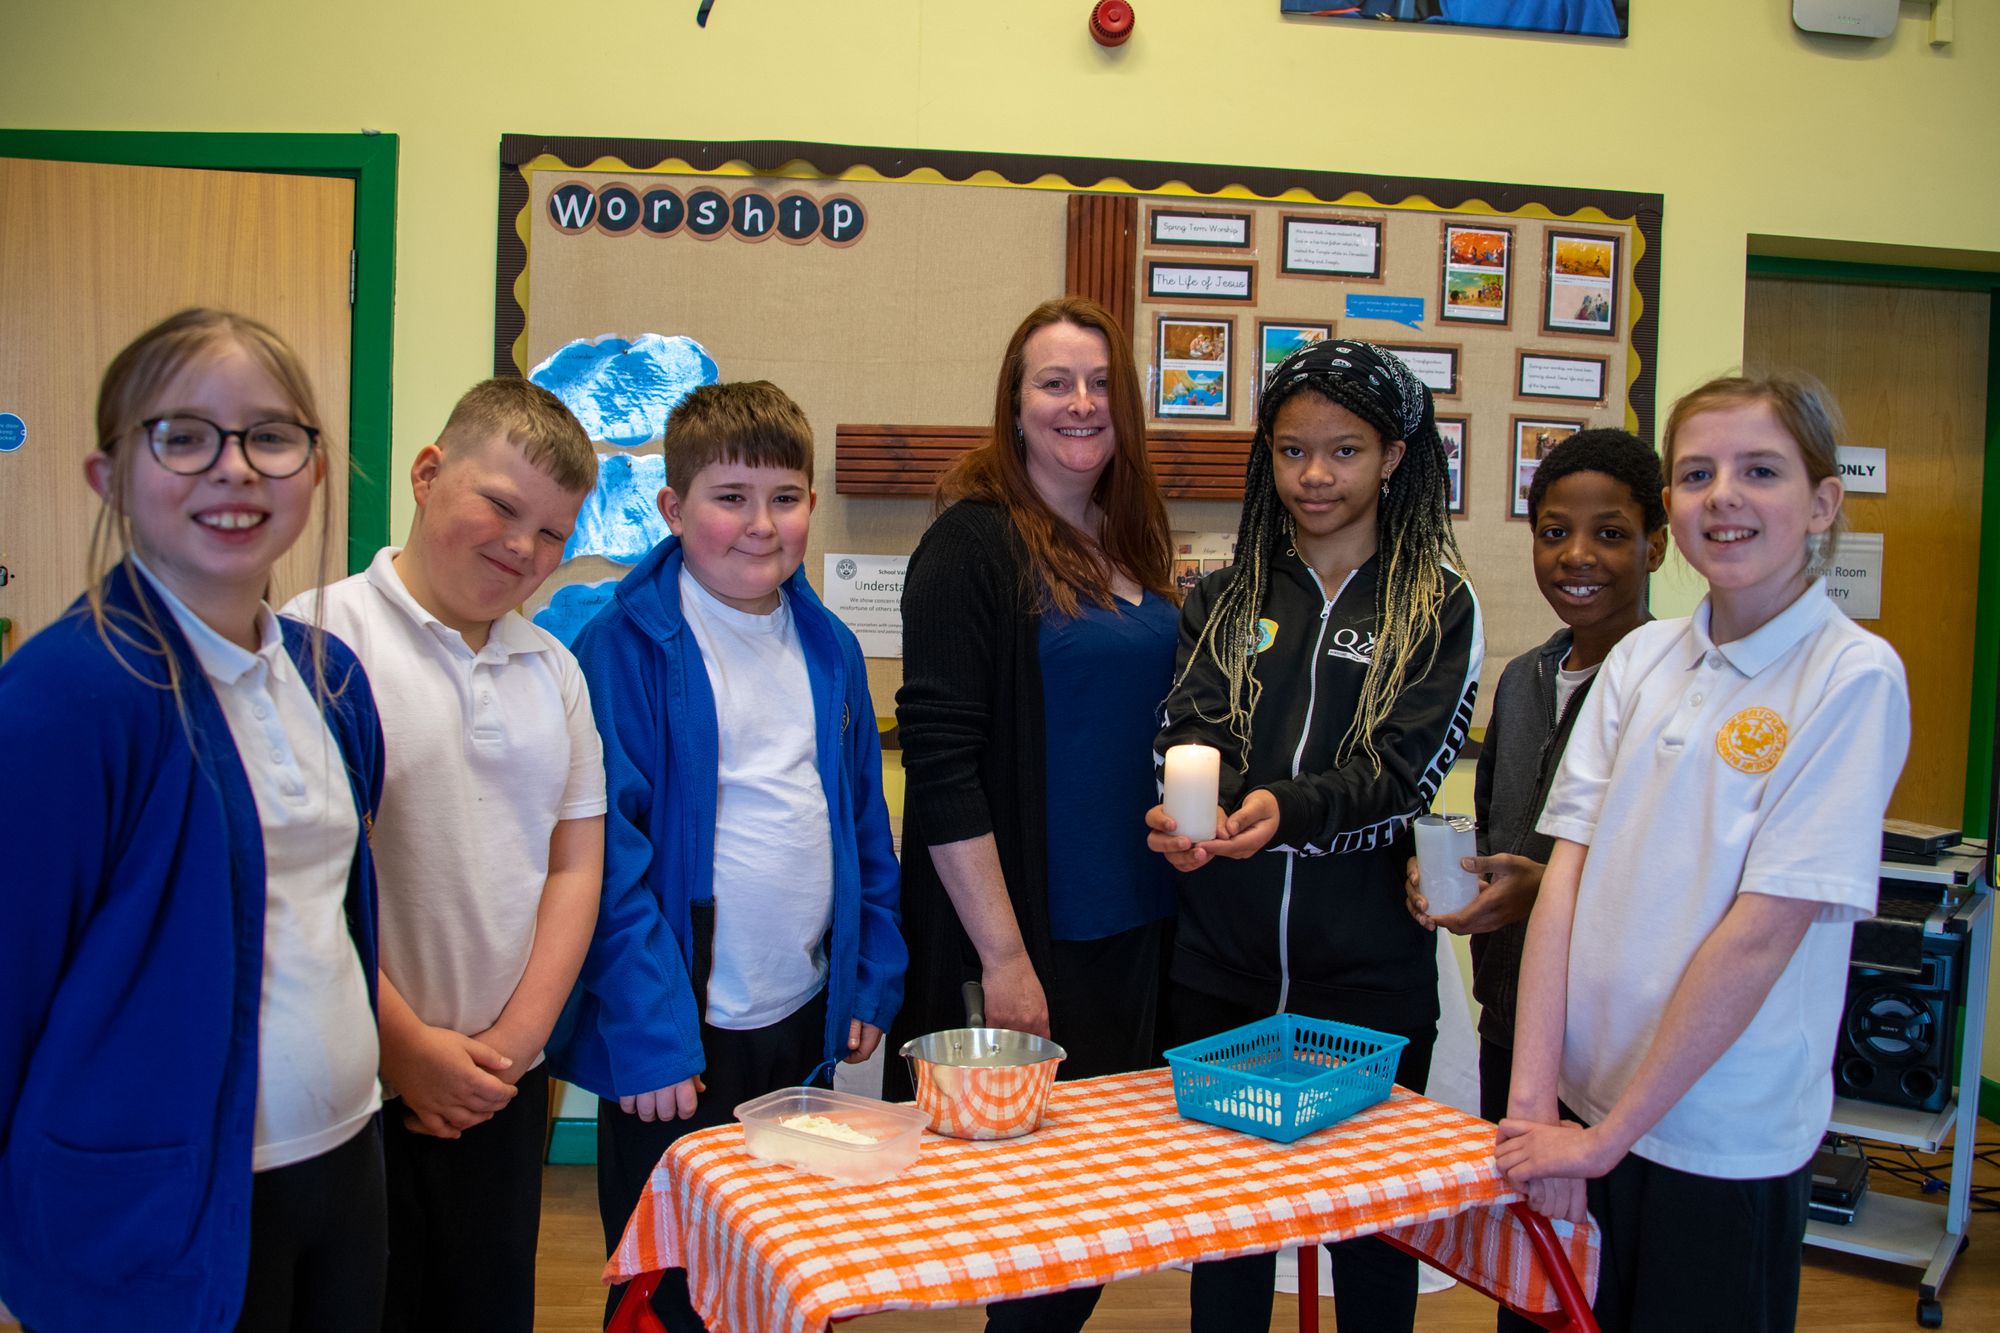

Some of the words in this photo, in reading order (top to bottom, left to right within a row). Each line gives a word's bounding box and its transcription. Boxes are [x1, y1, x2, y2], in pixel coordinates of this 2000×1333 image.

[553, 193, 853, 239] Worship
[1163, 221, 1187, 234] Spring
[1189, 223, 1207, 232] Term
[1209, 225, 1239, 235] Worship
[1156, 273, 1176, 286] The
[1179, 275, 1199, 290] Life
[1201, 276, 1213, 291] of
[1215, 276, 1246, 288] Jesus
[1835, 566, 1867, 578] Room
[855, 580, 904, 592] Understa
[1827, 587, 1850, 600] ntry
